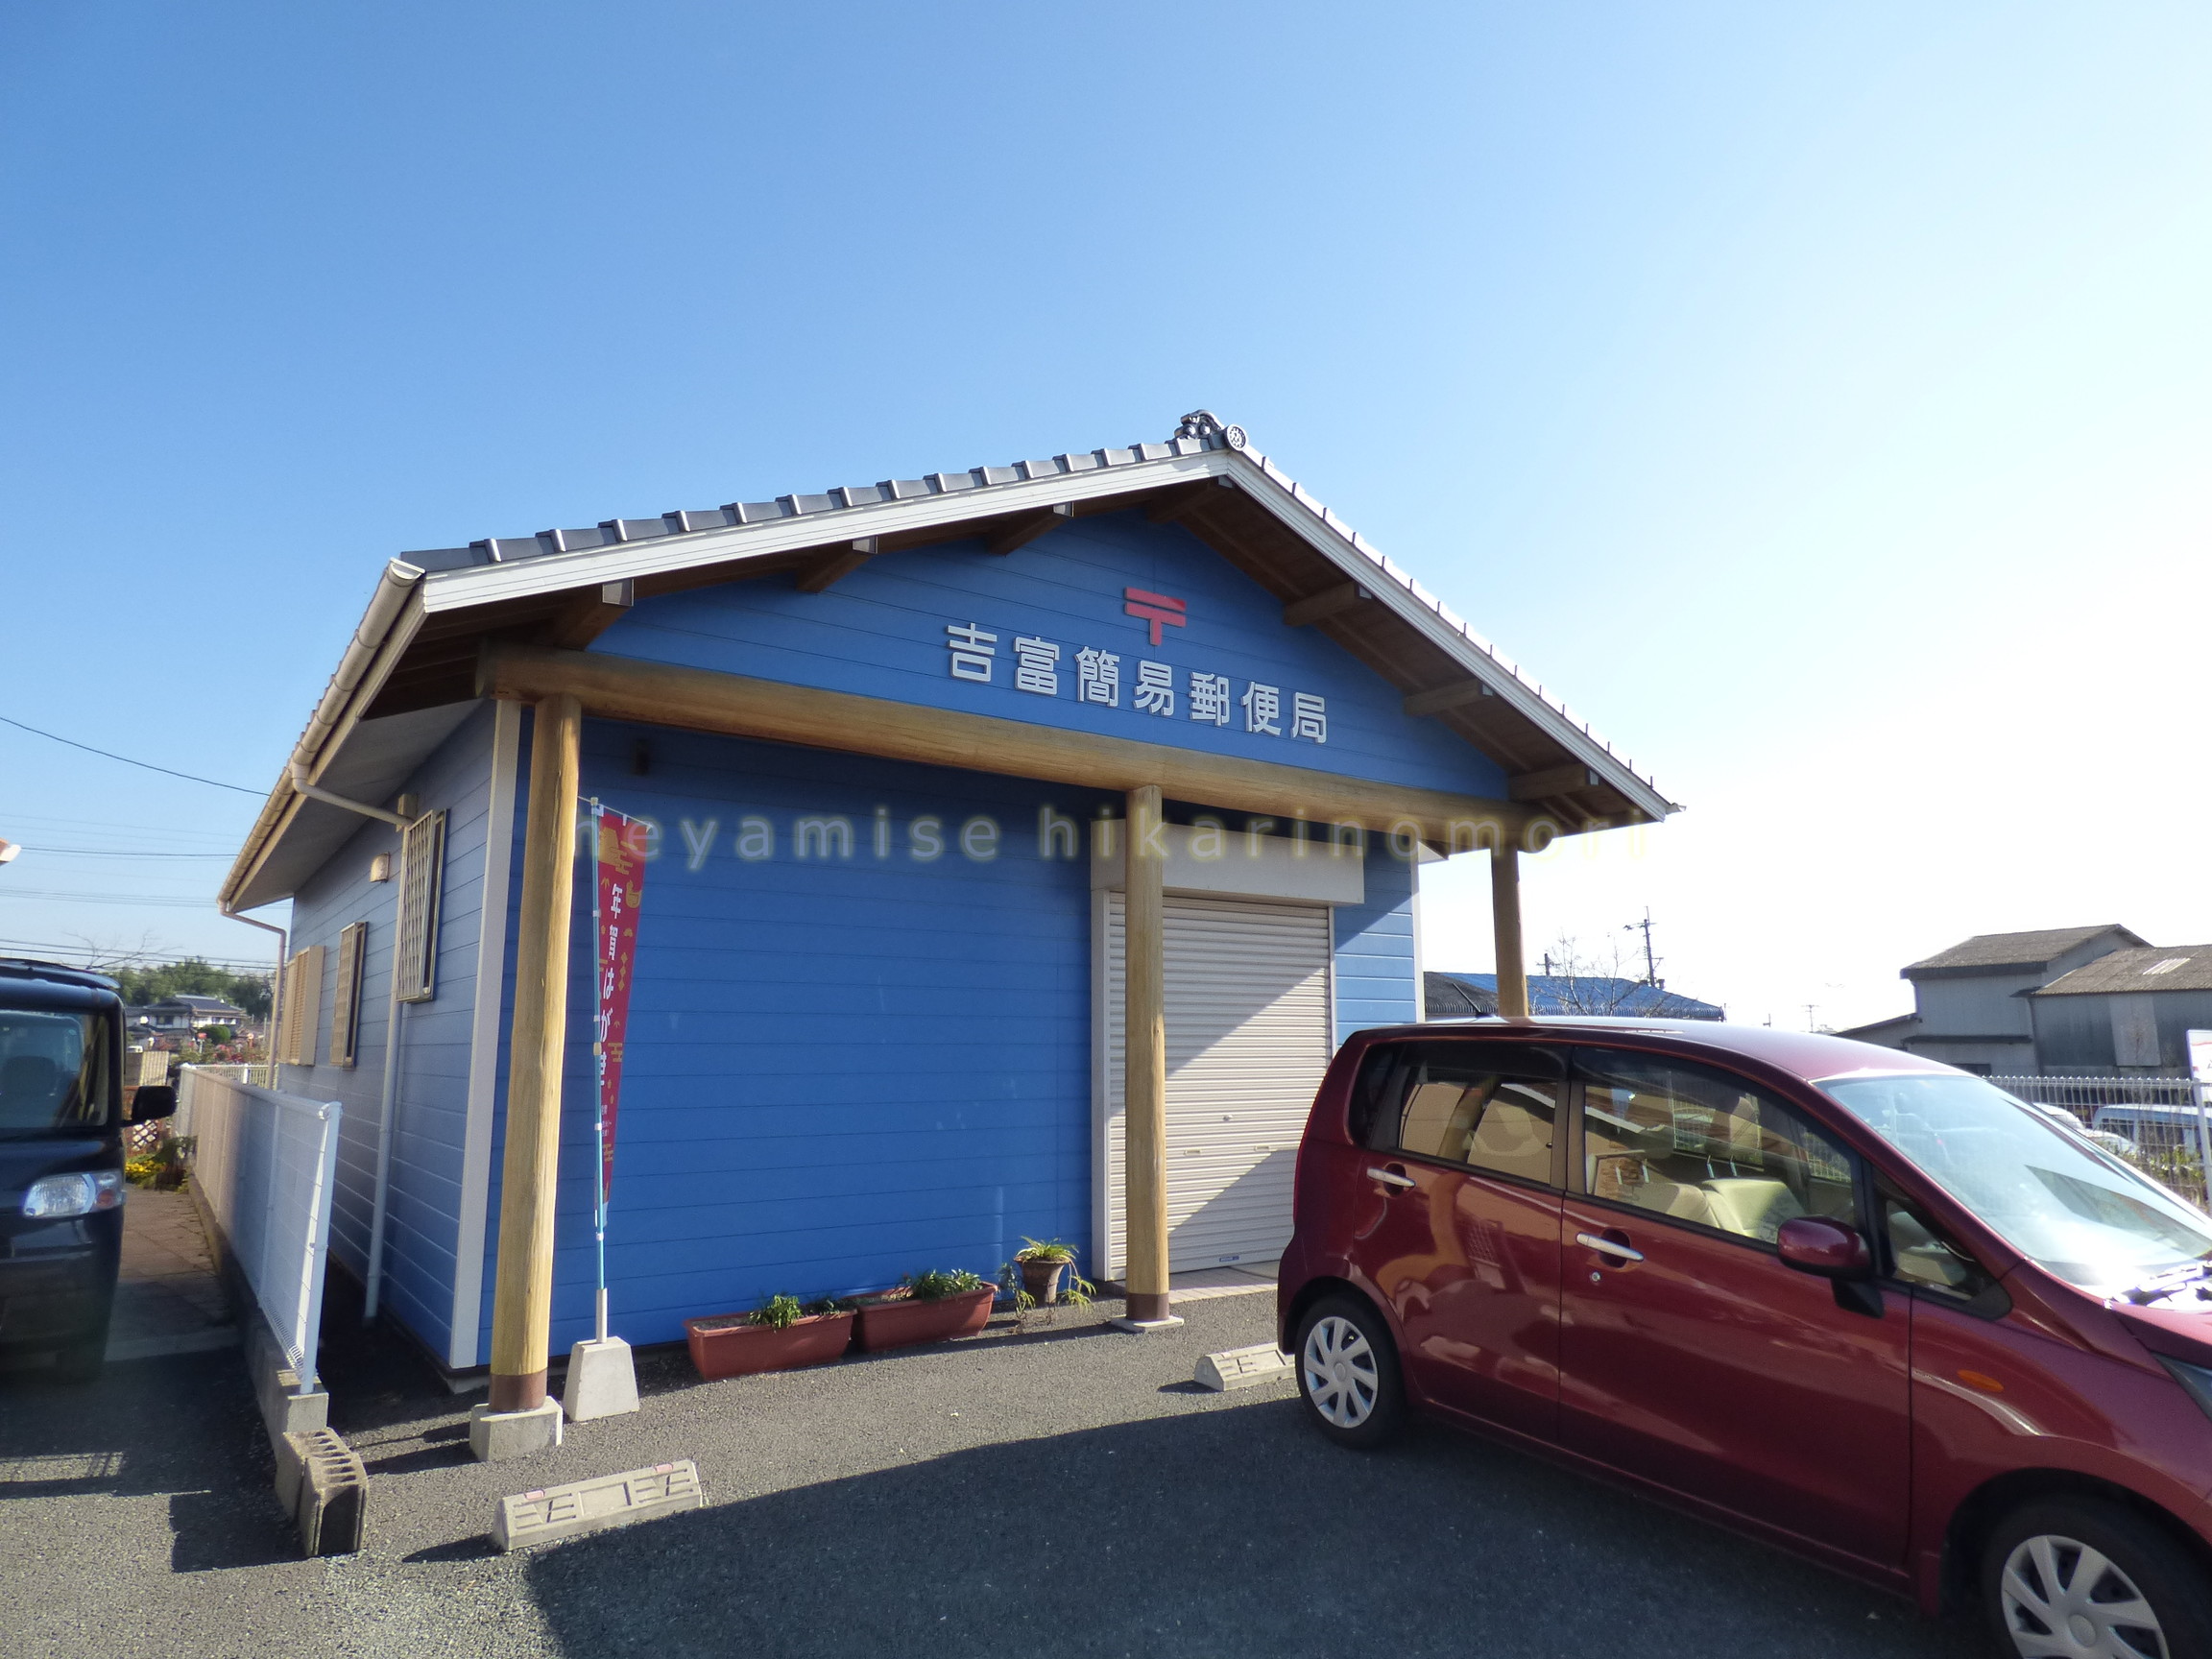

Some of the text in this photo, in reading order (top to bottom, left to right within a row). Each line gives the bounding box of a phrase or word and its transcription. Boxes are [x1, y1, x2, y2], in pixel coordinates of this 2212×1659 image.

[946, 622, 1328, 745] 吉富簡易郵便局
